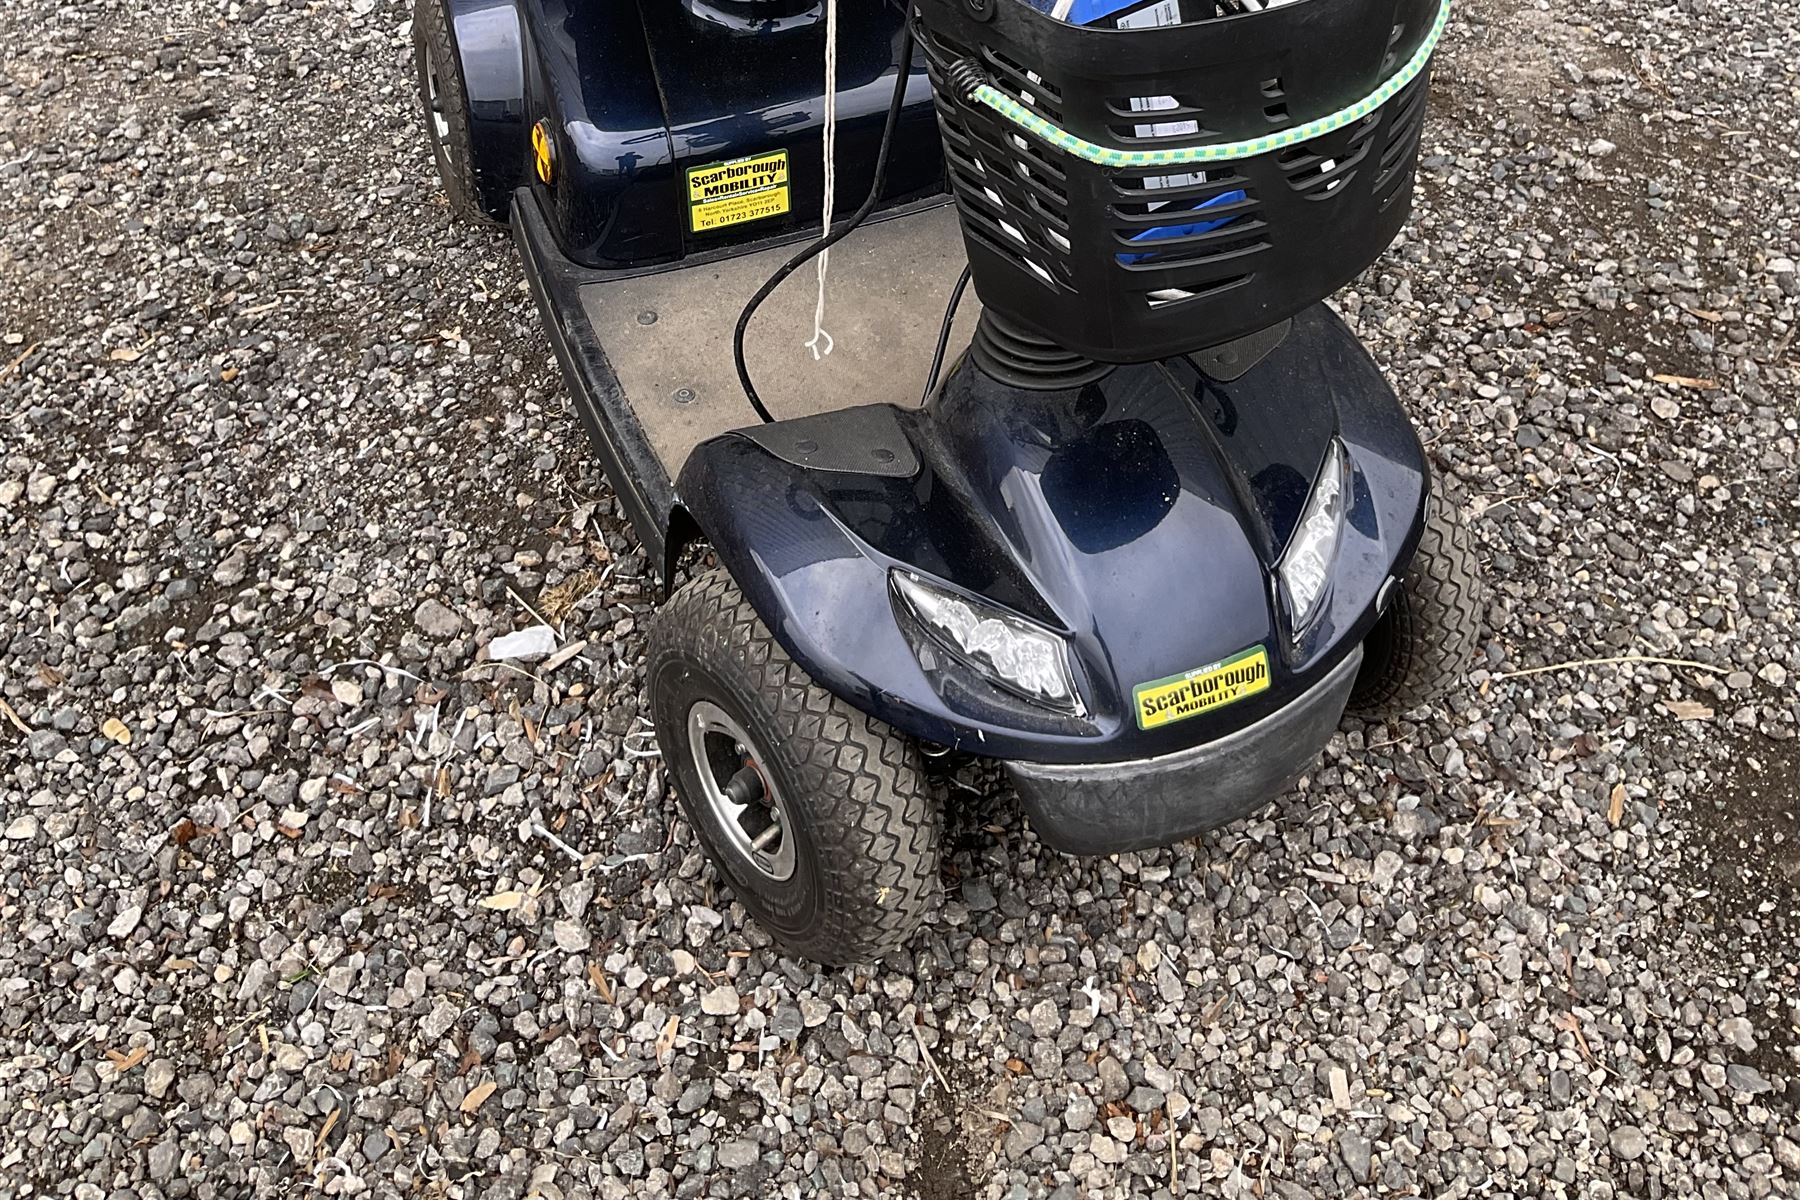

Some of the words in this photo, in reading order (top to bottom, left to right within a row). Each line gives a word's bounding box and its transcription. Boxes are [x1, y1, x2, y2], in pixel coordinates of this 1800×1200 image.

[691, 159, 785, 188] Scarborough
[704, 173, 777, 197] MOBILITY
[722, 204, 748, 214] Yorkshire
[746, 192, 780, 202] Scarborough
[719, 211, 746, 223] 01723
[749, 203, 781, 217] 377515
[1142, 662, 1265, 716] Scarborough
[1176, 686, 1239, 715] MOBILITY
